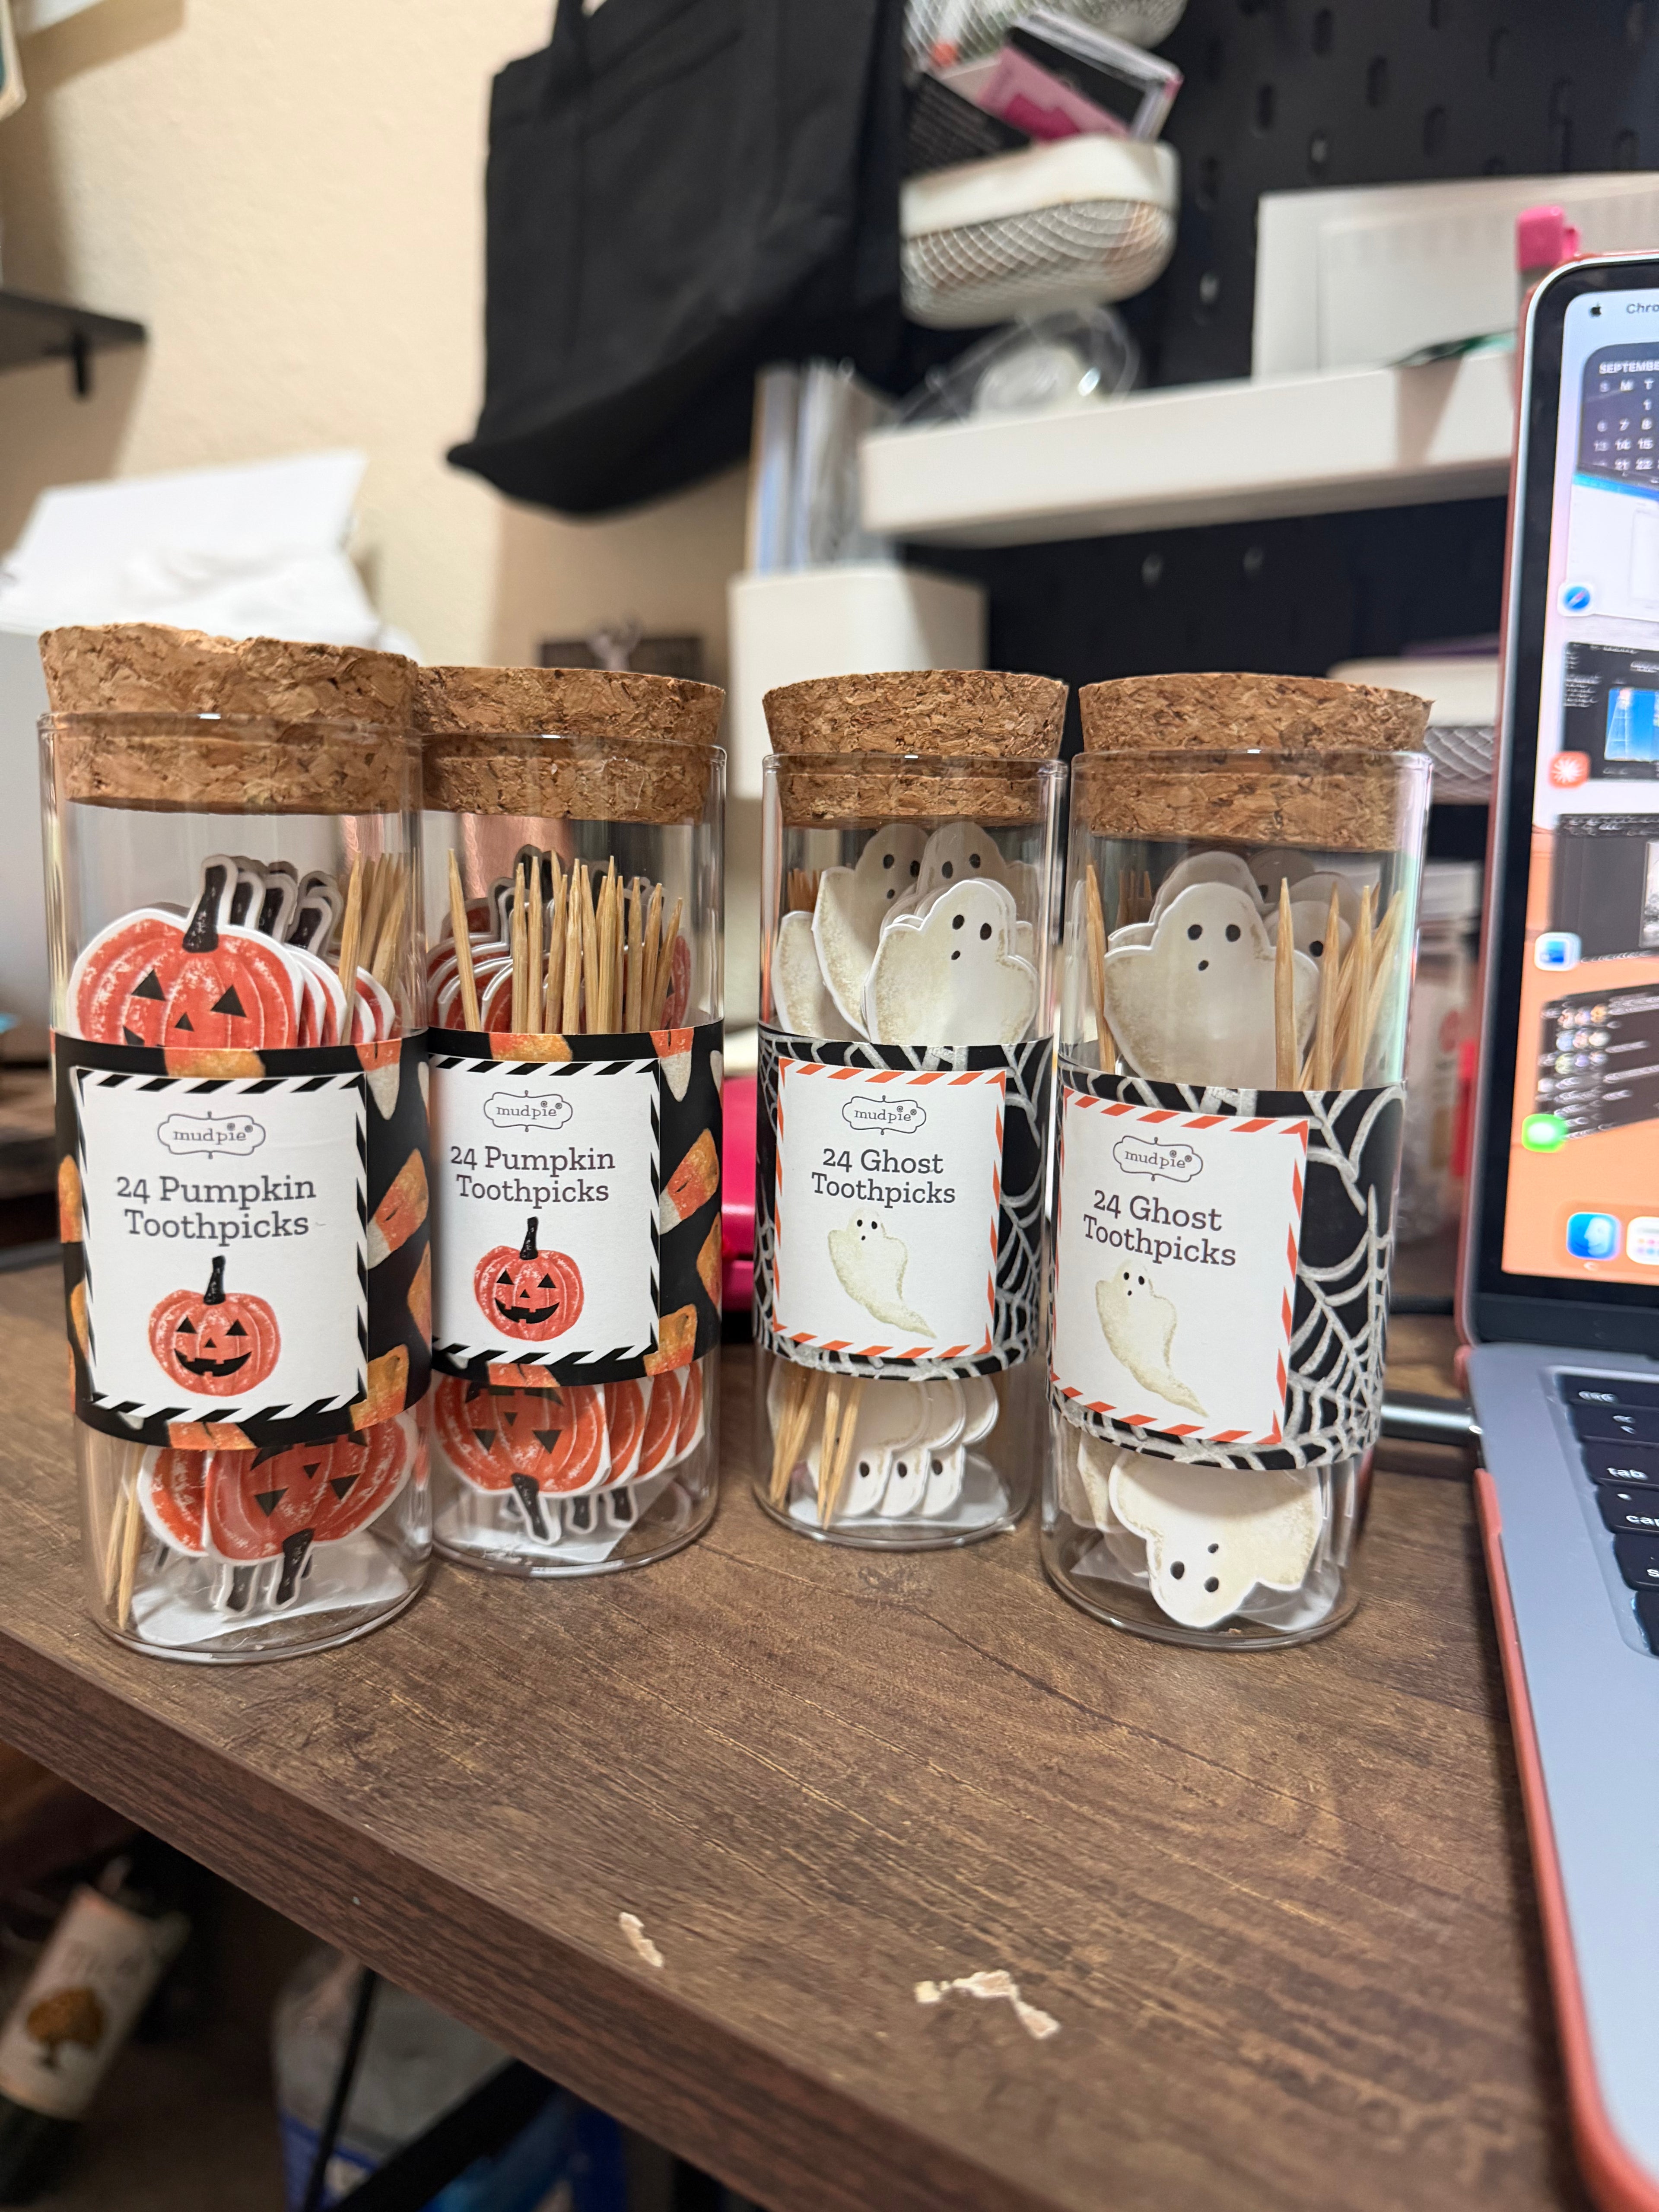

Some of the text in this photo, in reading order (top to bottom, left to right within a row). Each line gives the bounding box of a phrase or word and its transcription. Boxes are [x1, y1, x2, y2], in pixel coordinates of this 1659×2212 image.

[450, 1145, 616, 1178] 24 Pumpkin
[823, 1148, 944, 1174] 24 Ghost
[117, 1175, 317, 1211] 24 Pumpkin
[455, 1174, 610, 1209] Toothpicks
[811, 1172, 956, 1209] Toothpicks
[124, 1209, 309, 1247] Toothpicks
[1093, 1189, 1223, 1231] 24 Ghost
[1083, 1214, 1236, 1266] Toothpicks
[1606, 1468, 1648, 1480] tab
